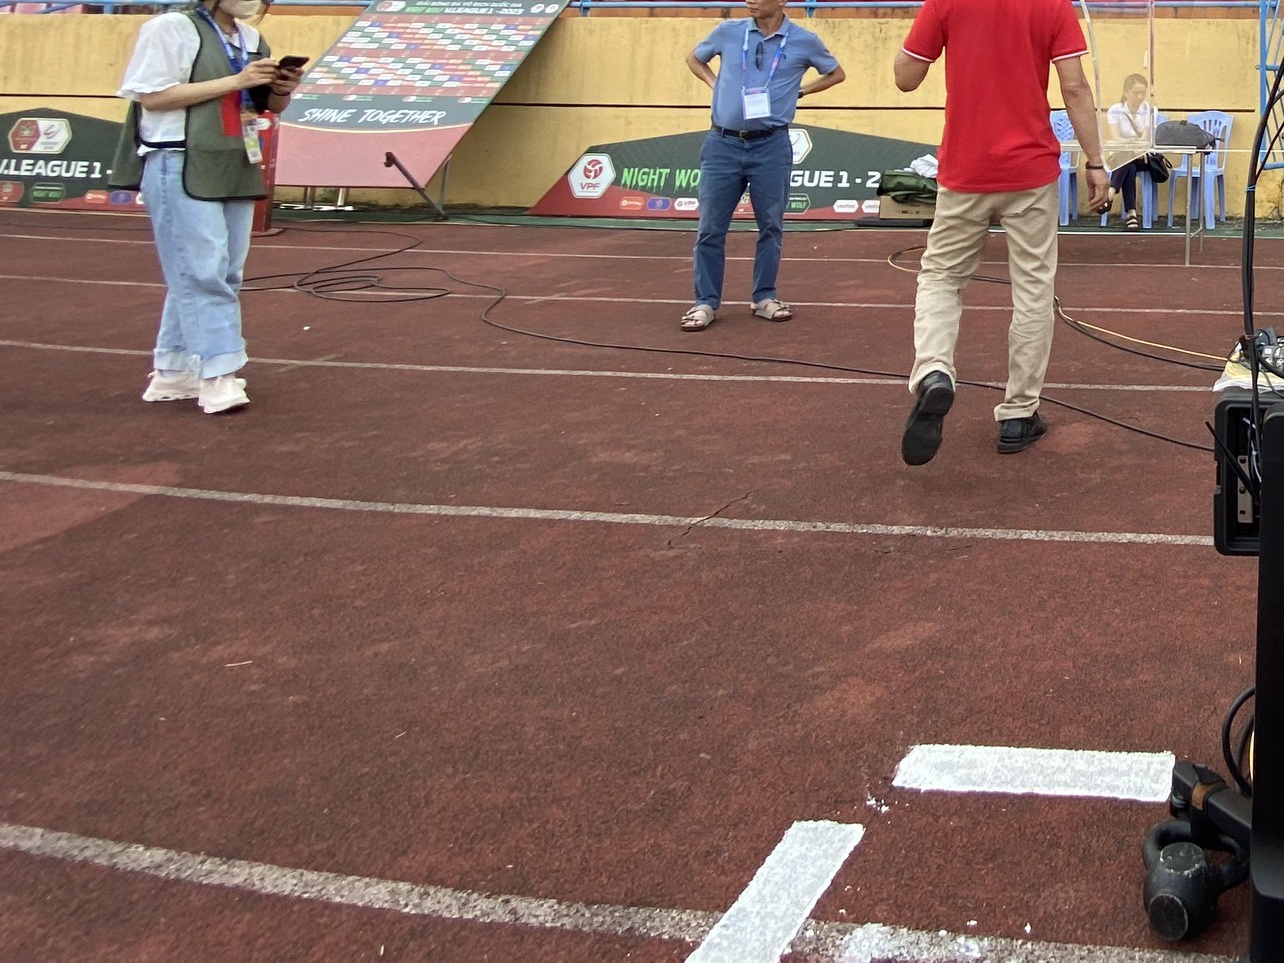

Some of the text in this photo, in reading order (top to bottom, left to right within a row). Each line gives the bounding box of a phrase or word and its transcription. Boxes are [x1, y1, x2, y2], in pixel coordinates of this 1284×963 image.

[298, 108, 447, 126] SHINE TOGETHER
[620, 167, 701, 193] NIGHT WO
[790, 170, 835, 188] GUE
[837, 170, 850, 188] 1
[866, 171, 881, 188] 2
